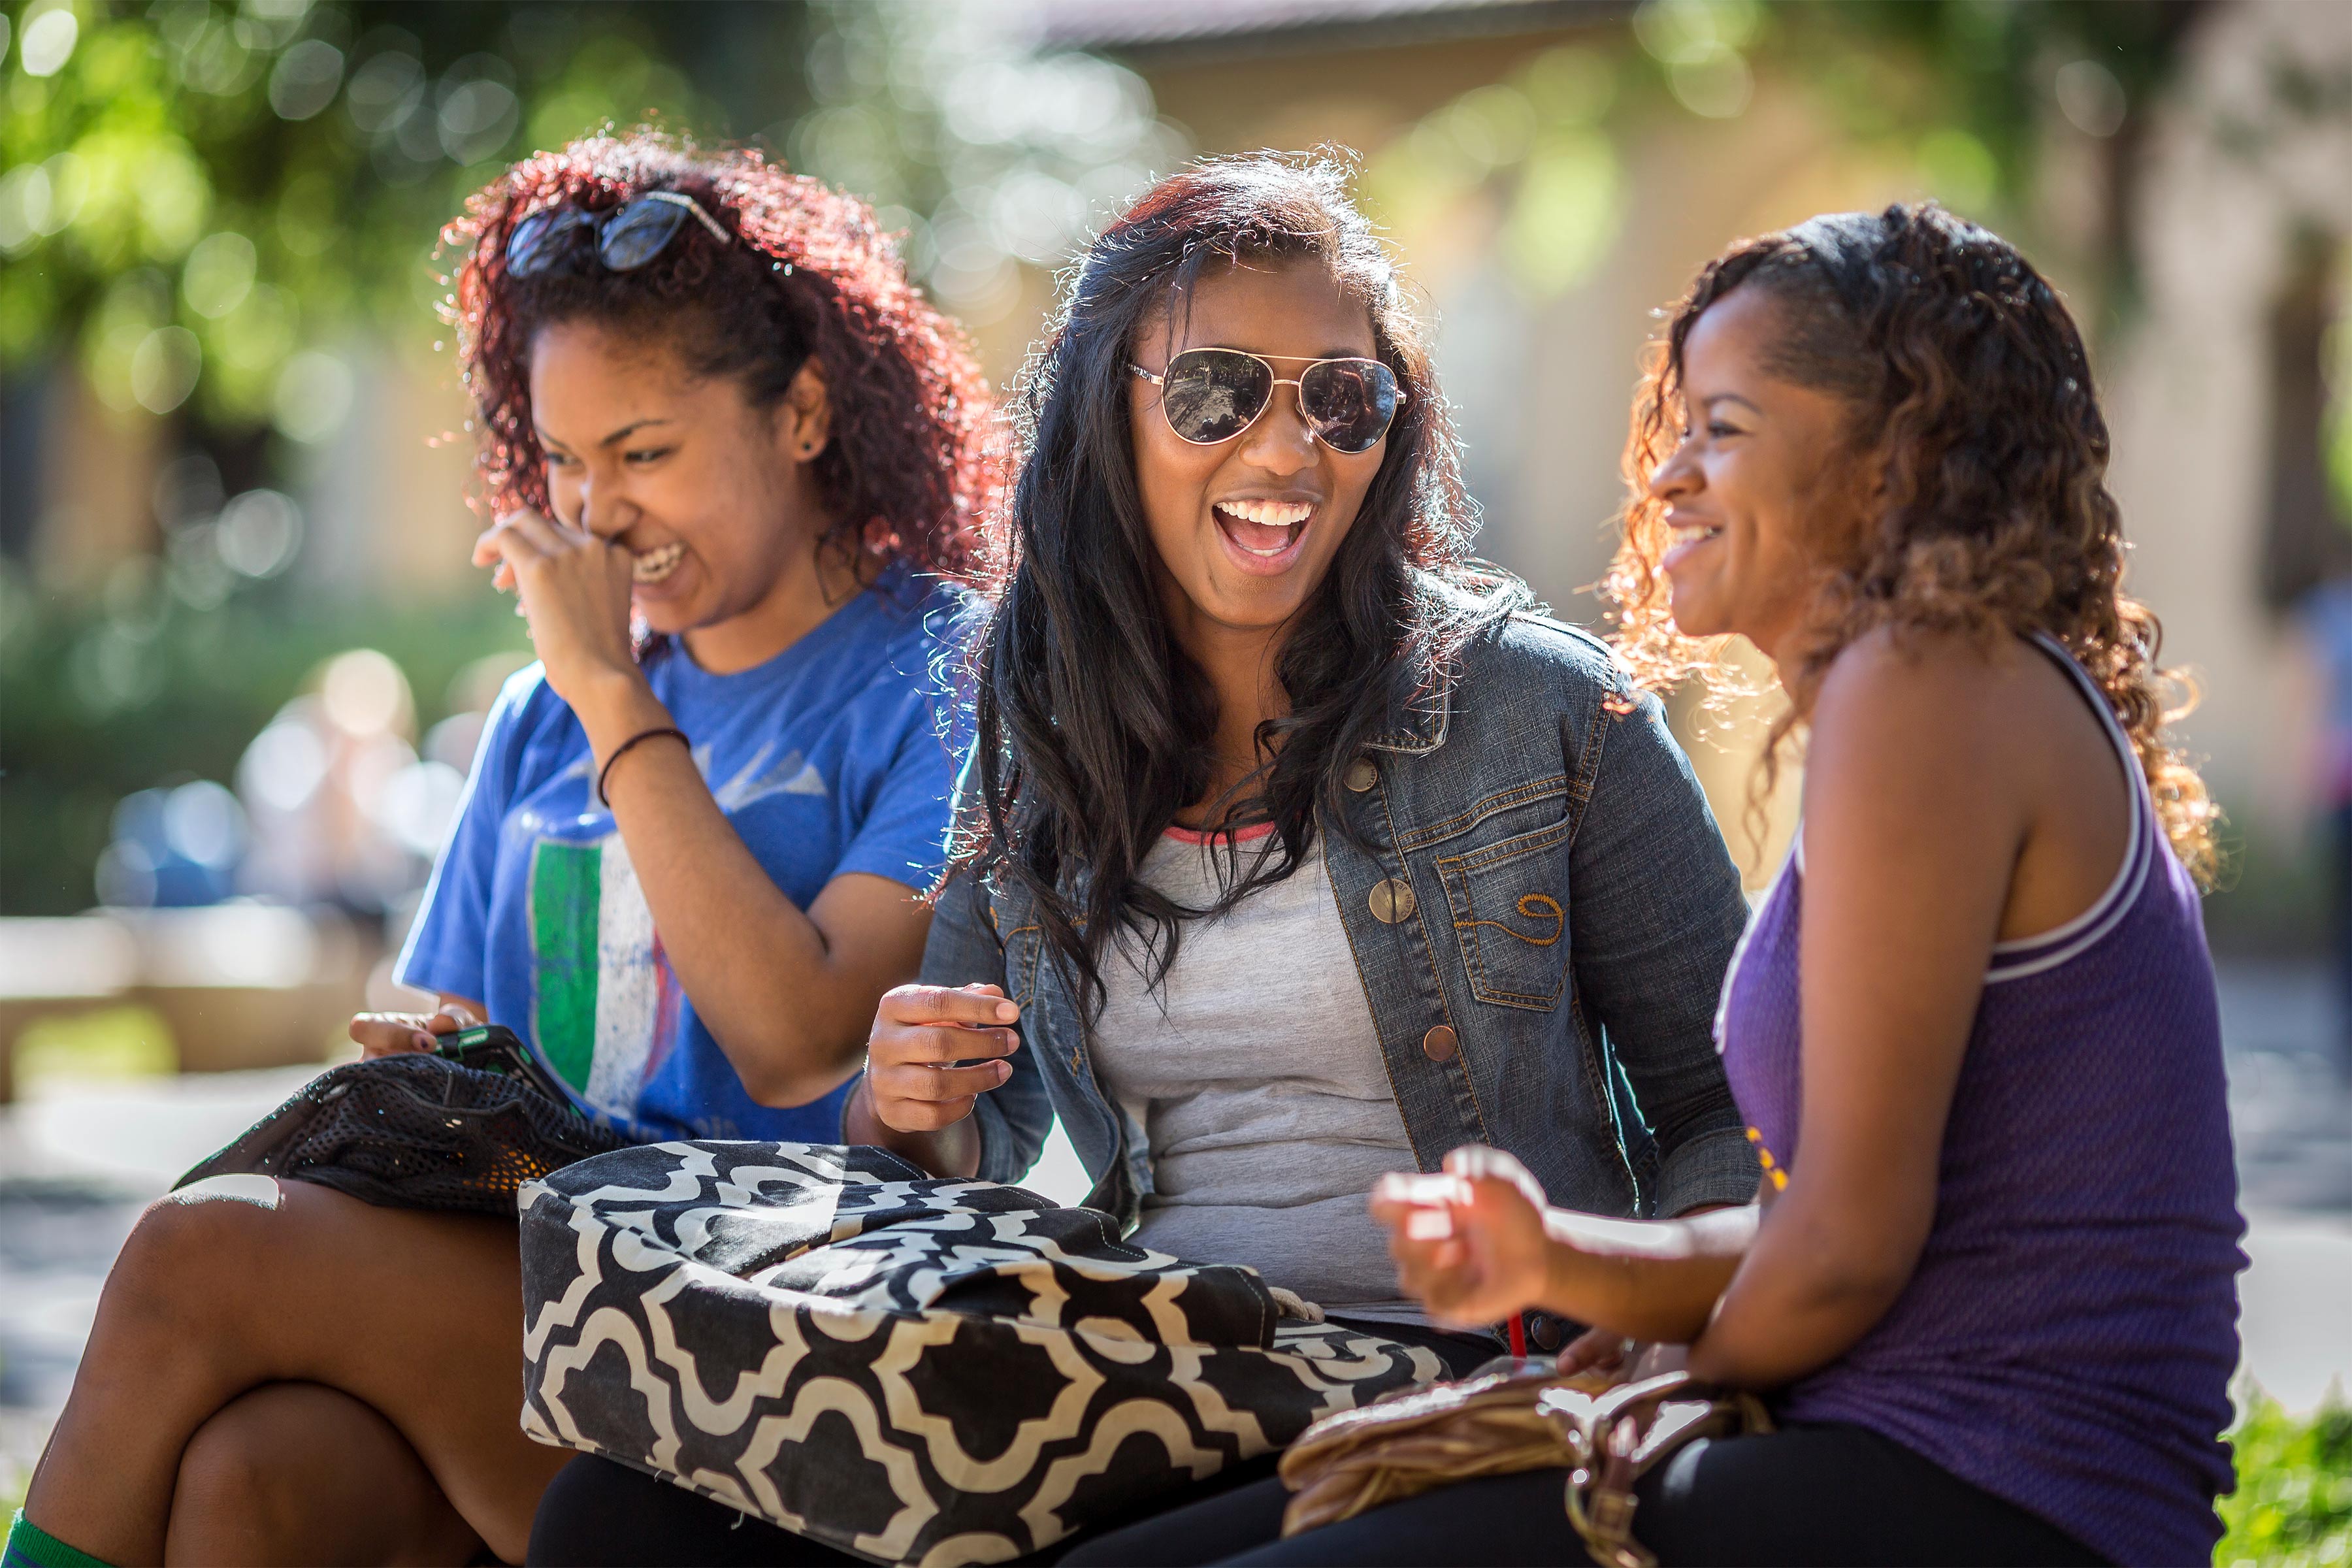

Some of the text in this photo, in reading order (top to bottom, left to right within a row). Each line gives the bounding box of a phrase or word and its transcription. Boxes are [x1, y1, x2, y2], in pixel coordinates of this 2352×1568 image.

[1366, 768, 1376, 787] CLASH
[1383, 881, 1413, 917] CLASH JEAS
